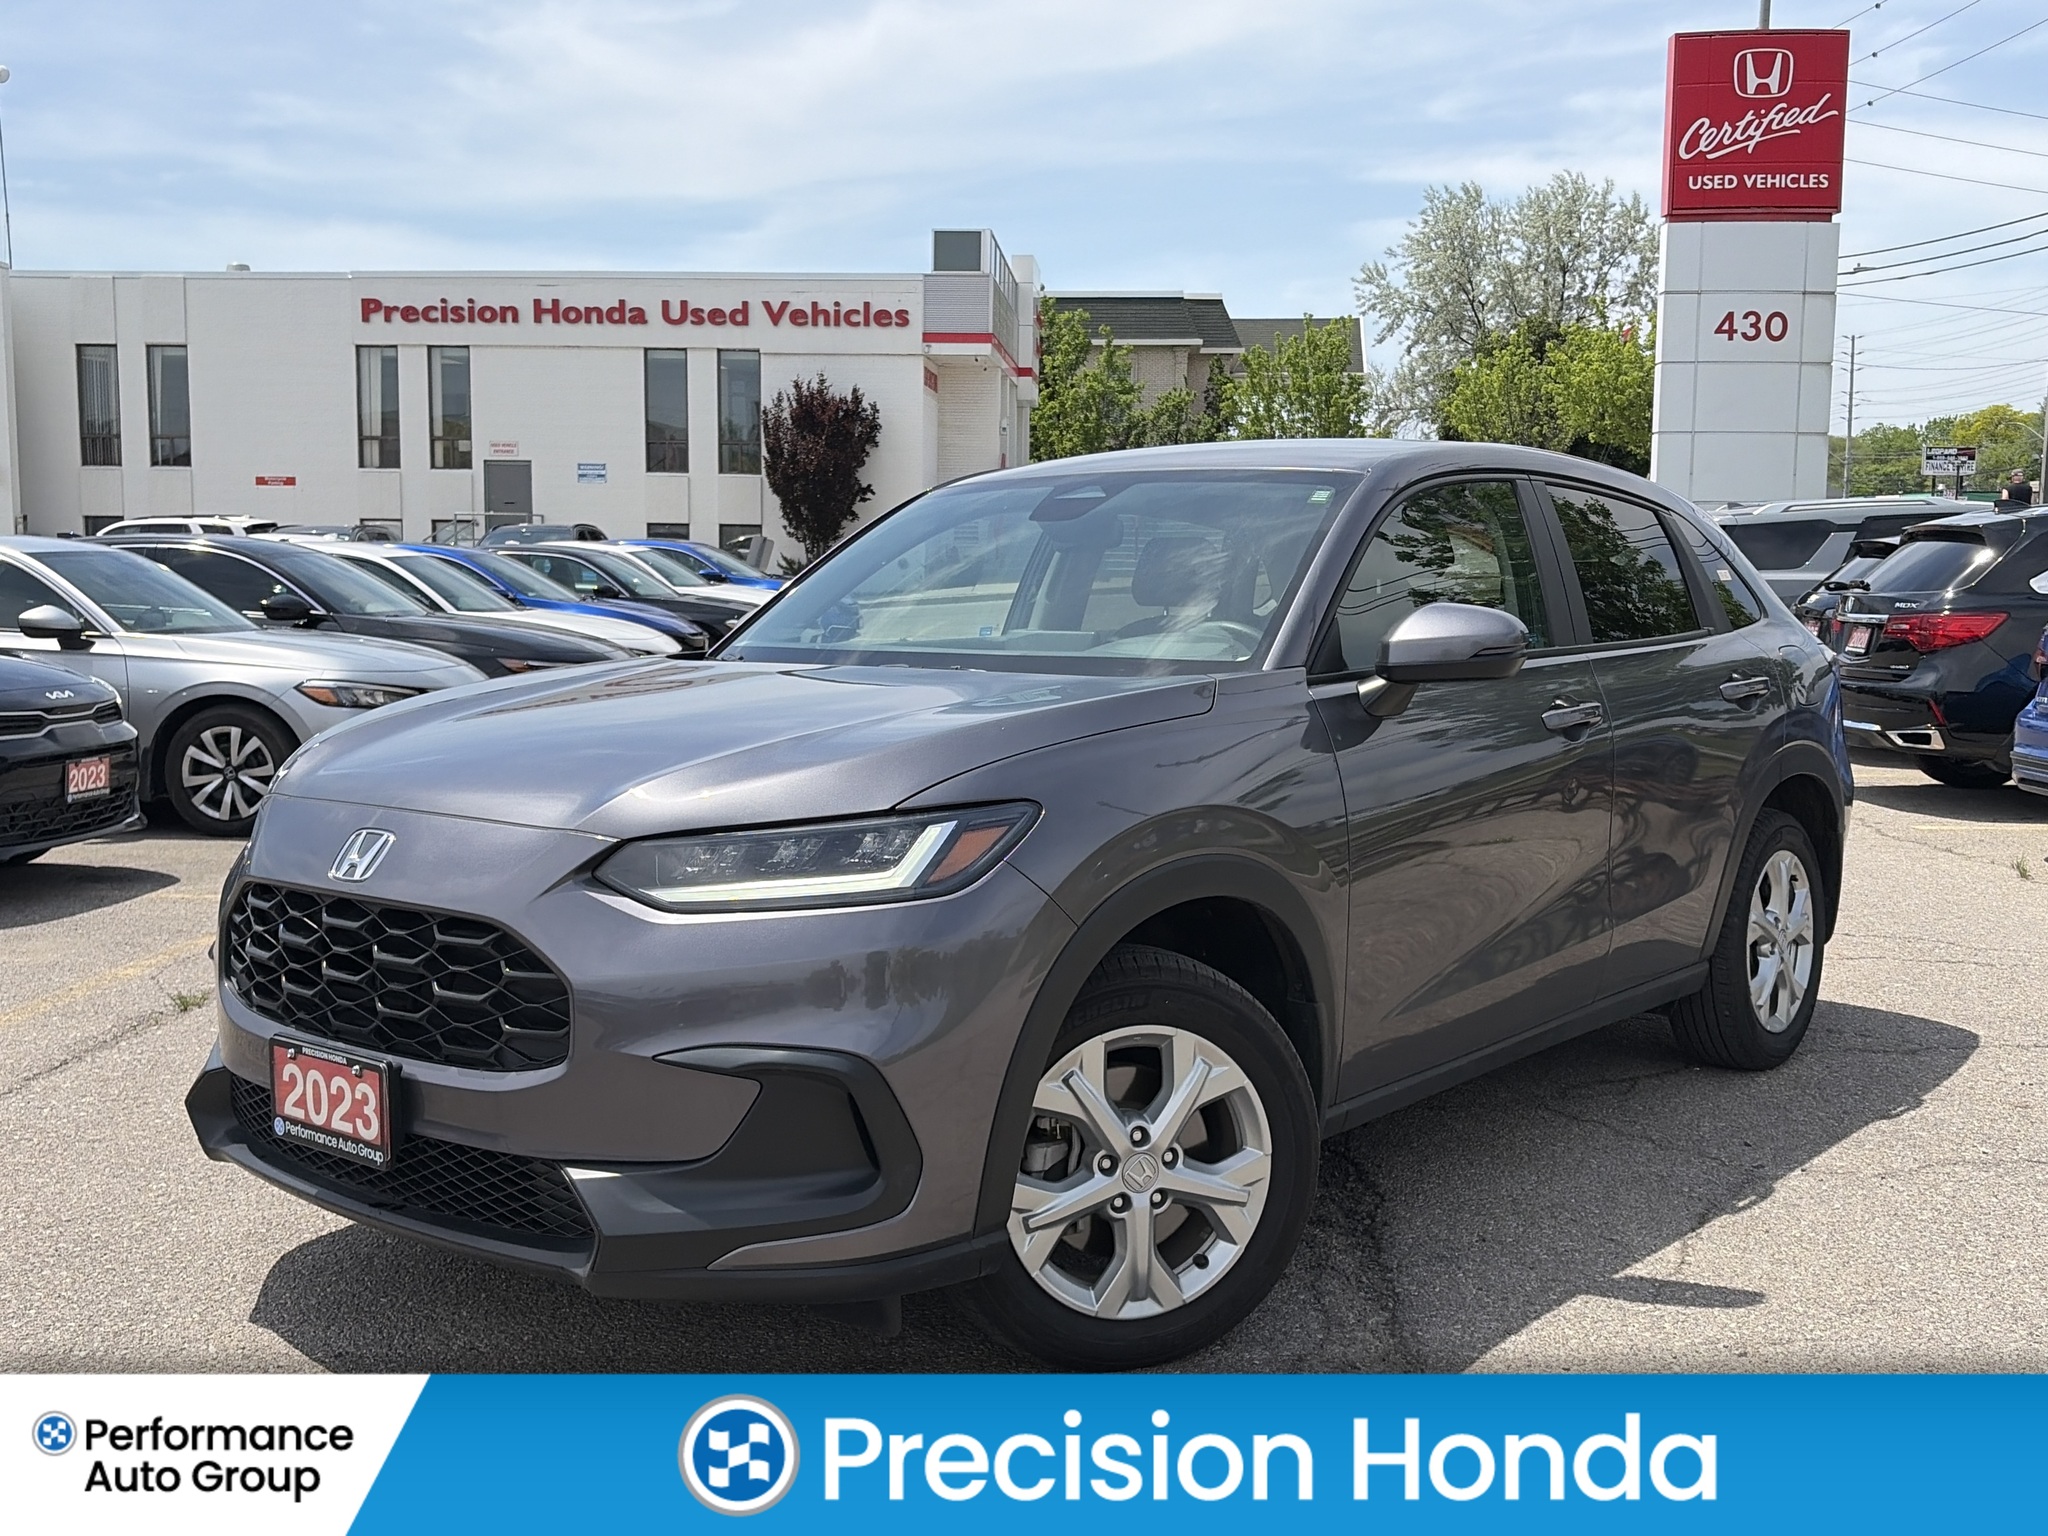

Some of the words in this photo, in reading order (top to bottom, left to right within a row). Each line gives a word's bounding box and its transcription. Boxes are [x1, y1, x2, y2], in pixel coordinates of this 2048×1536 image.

[1678, 93, 1839, 160] Certified
[1688, 174, 1738, 190] USED
[1743, 173, 1829, 189] VEHICLES
[361, 298, 519, 324] Precision
[533, 298, 648, 326] Honda
[662, 299, 750, 327] Used
[762, 300, 910, 328] Vehicles
[1714, 310, 1789, 342] 430
[68, 764, 106, 793] 2023
[302, 1047, 329, 1060] PRECISION
[328, 1053, 348, 1065] HONDA
[282, 1063, 380, 1141] 2023
[285, 1121, 338, 1147] Performance
[338, 1137, 358, 1154] Auto
[358, 1144, 384, 1165] Group
